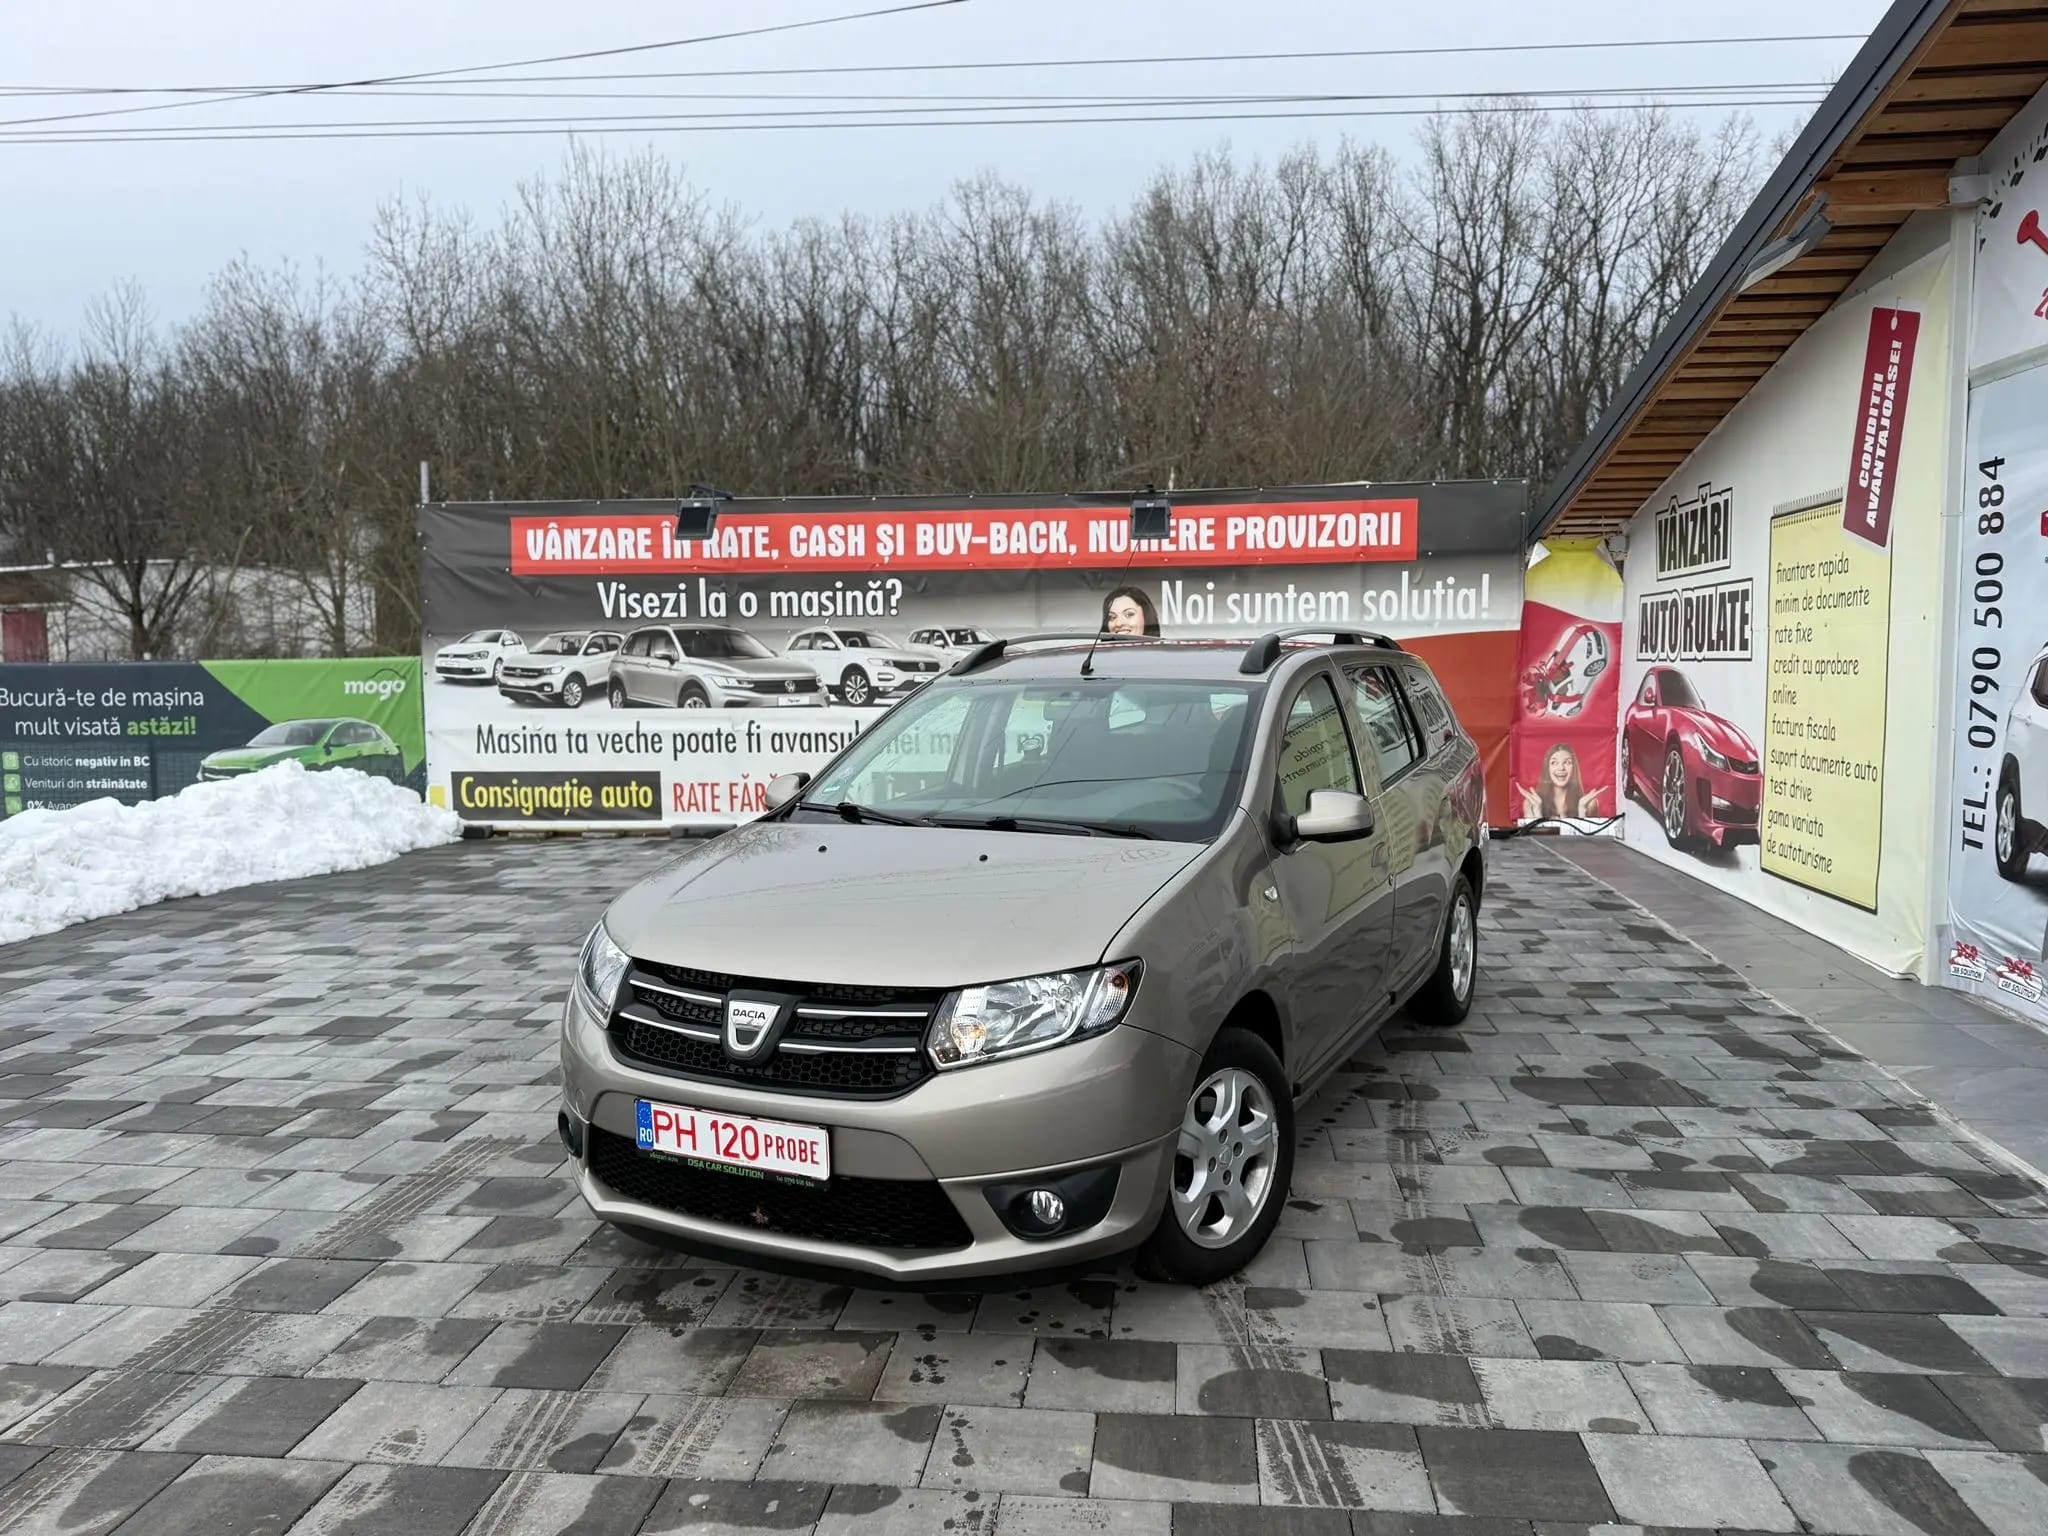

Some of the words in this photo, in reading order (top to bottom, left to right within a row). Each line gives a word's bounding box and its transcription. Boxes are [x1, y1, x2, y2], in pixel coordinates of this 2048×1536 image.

[1859, 373, 1884, 488] CONDITII
[1866, 339, 1903, 529] AVANTAJOASE!
[1978, 456, 2006, 536] 884
[526, 521, 653, 560] VÂNZARE
[703, 525, 779, 560] RATE,
[789, 523, 866, 558] CASH
[875, 522, 905, 564] ȘI
[916, 520, 1077, 556] BUY-BACK,
[1226, 511, 1402, 550] PROVIZORII
[1658, 492, 1730, 573] VÂNZĂRI
[1775, 561, 1816, 584] finantare
[1818, 551, 1849, 583] rapida
[597, 581, 687, 618] Visezi
[699, 577, 727, 618] la
[739, 590, 758, 618] o
[770, 578, 903, 624] mașină?
[1161, 579, 1215, 625] Noi
[1226, 584, 1349, 625] suntem
[1775, 592, 1800, 614] minim
[1802, 589, 1814, 611] de
[1816, 585, 1870, 610] documente
[1974, 552, 2004, 629] 500
[1774, 625, 1793, 644] rate
[1795, 621, 1813, 644] fixe
[1774, 653, 1800, 675] credit
[1802, 658, 1813, 675] cu
[1815, 652, 1859, 682] aprobare
[0, 687, 96, 707] Bucură-te
[101, 687, 127, 707] de
[132, 687, 205, 711] mașina
[343, 679, 406, 701] mogo
[1772, 683, 1798, 705] online
[1968, 647, 2001, 749] 0790
[15, 716, 61, 736] mult
[64, 716, 121, 736] visată
[126, 715, 197, 736] astăzi!
[566, 728, 588, 754] ta
[597, 720, 663, 754] veche
[672, 728, 737, 762] poate
[746, 720, 762, 753] fi
[1771, 713, 1804, 738] factura
[1806, 716, 1836, 742] fiscala
[23, 755, 39, 768] Cu
[41, 755, 74, 768] istoric
[75, 756, 119, 769] negativ
[133, 755, 151, 768] BC
[1770, 748, 1798, 771] suport
[1800, 748, 1851, 778] documente
[1854, 760, 1878, 782] auto
[24, 777, 66, 790] Venituri
[67, 777, 84, 790] din
[86, 777, 148, 790] străinătate
[460, 776, 593, 816] Consignație
[601, 780, 653, 809] auto
[673, 782, 721, 813] RATE
[728, 773, 778, 813] FĂR
[1770, 776, 1787, 796] test
[1789, 778, 1813, 802] drive
[1767, 808, 1790, 829] gama
[1791, 813, 1824, 838] variata
[1766, 832, 1777, 854] de
[1778, 842, 1833, 874] autoturisme
[732, 1008, 766, 1020] DACIA
[639, 1127, 653, 1143] RO
[653, 1109, 697, 1151] PH
[709, 1119, 760, 1162] 120
[763, 1134, 820, 1166] PROBE
[687, 1158, 706, 1169] DSA
[706, 1161, 723, 1172] CAR
[723, 1164, 765, 1180] SOLUTION
